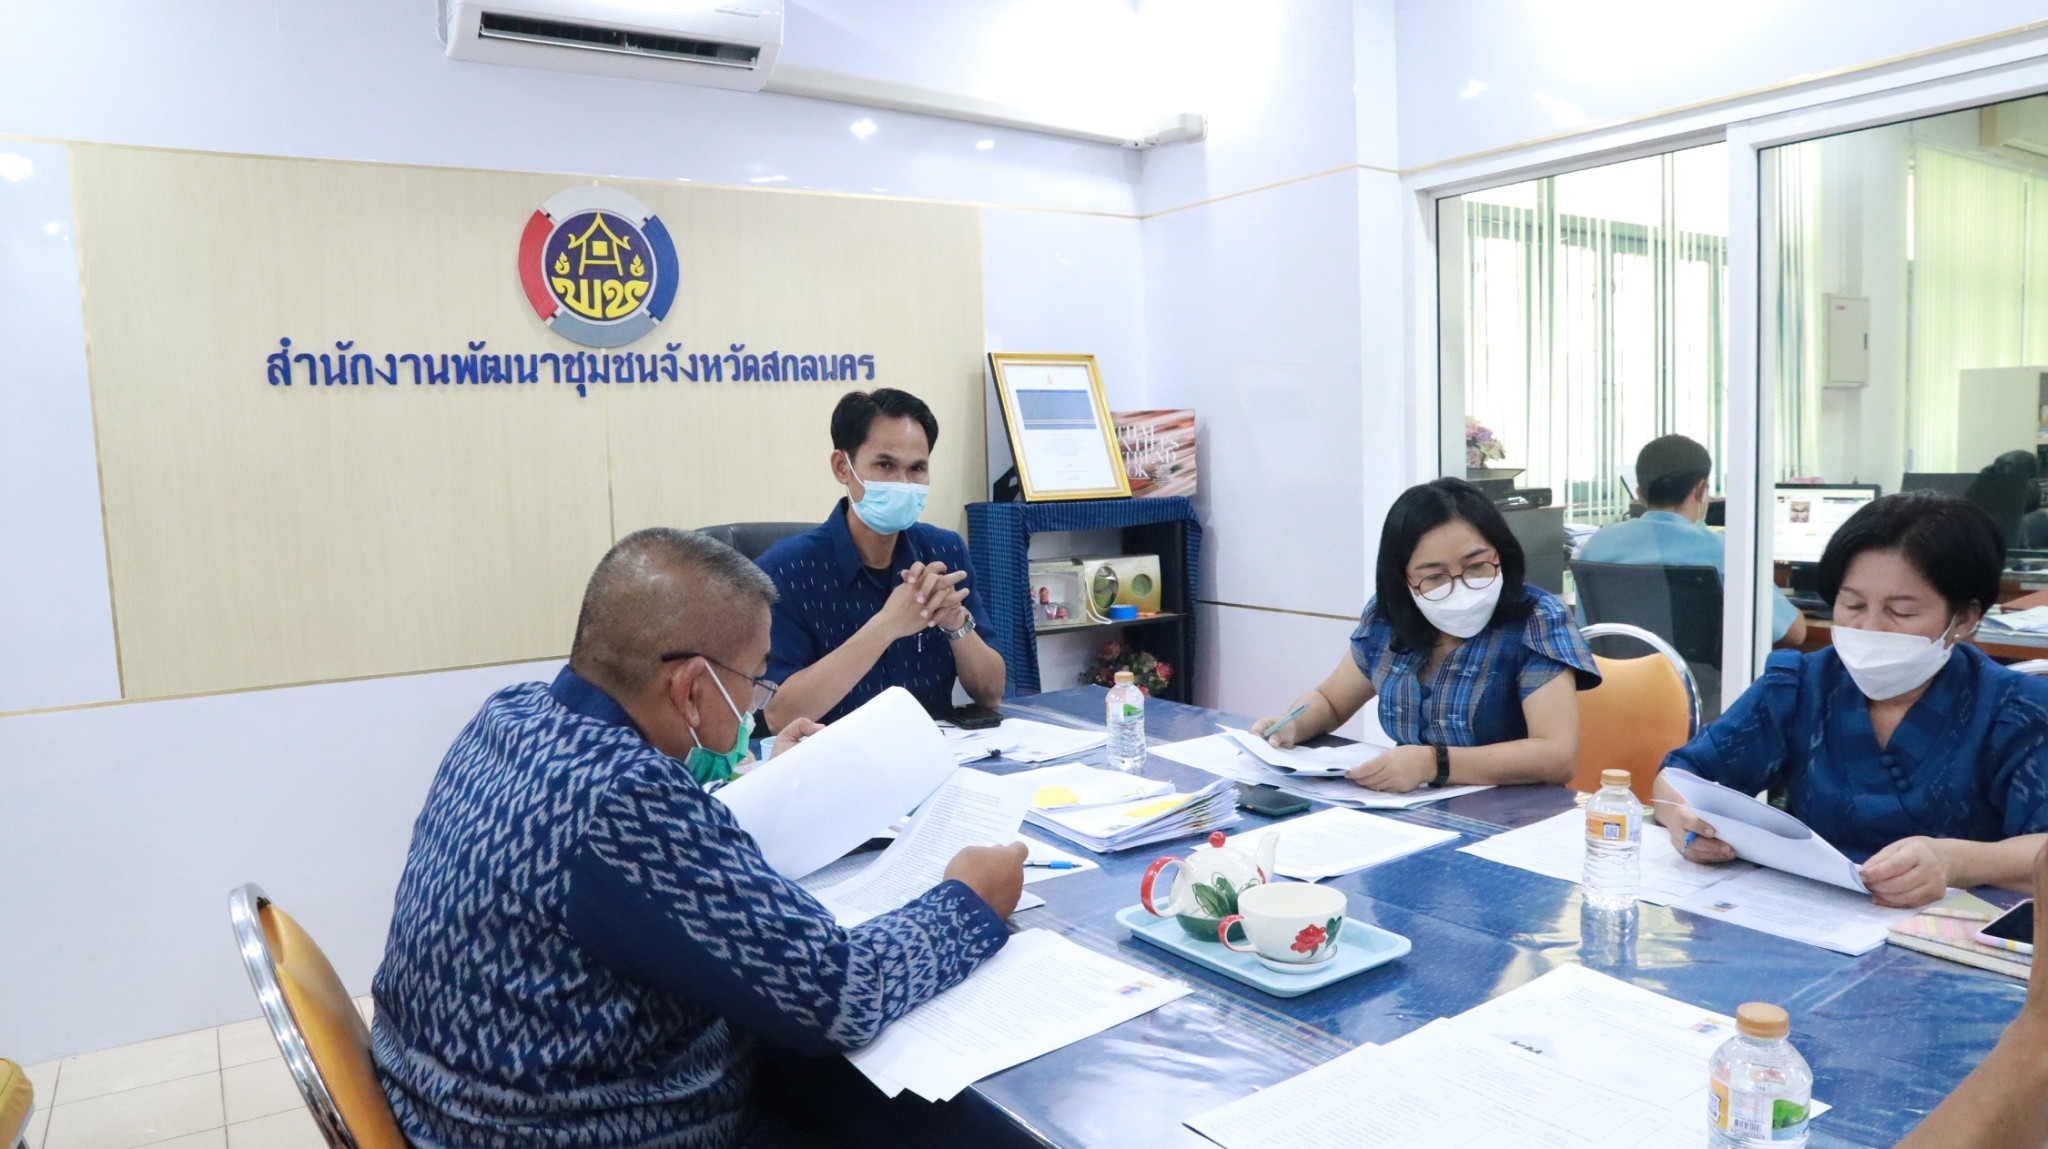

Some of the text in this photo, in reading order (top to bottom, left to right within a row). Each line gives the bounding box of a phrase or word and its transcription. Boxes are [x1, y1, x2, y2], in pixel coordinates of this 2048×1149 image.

[266, 336, 876, 398] สำนักงานพัฒนาชุมชนจังหวัดสกลนคร
[1118, 436, 1180, 453] XTILES
[1122, 449, 1177, 465] TREND
[1126, 463, 1149, 478] OK
